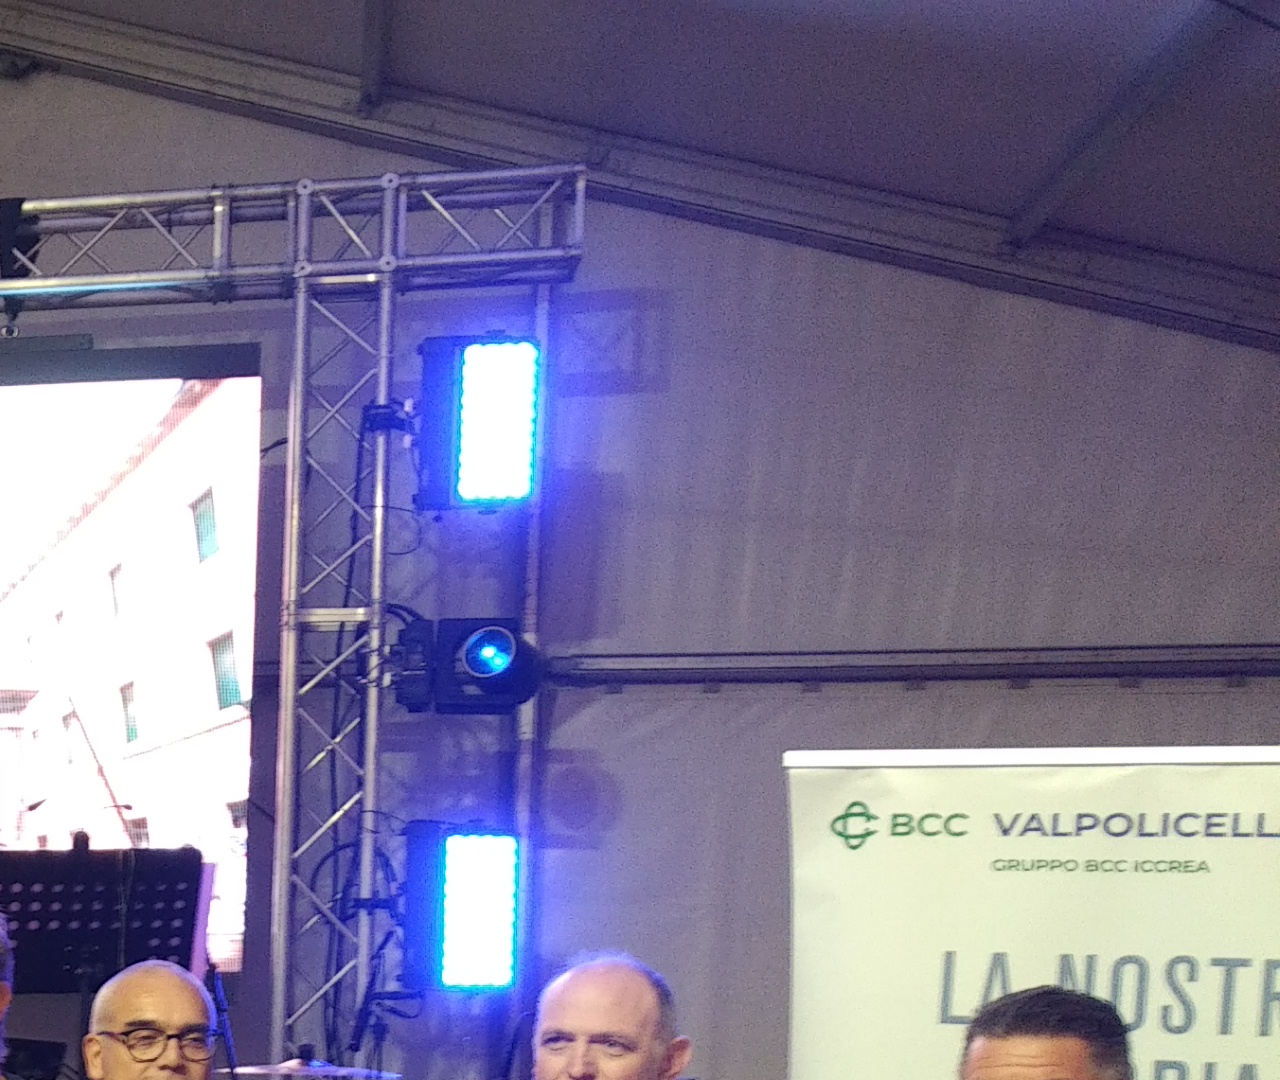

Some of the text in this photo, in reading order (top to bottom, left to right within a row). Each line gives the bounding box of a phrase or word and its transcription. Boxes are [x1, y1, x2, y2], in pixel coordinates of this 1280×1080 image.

[890, 812, 1280, 837] BCC VALPOLICELL
[991, 858, 1211, 873] GRUPPO BCC ICCREA
[940, 950, 1011, 1025] LA
